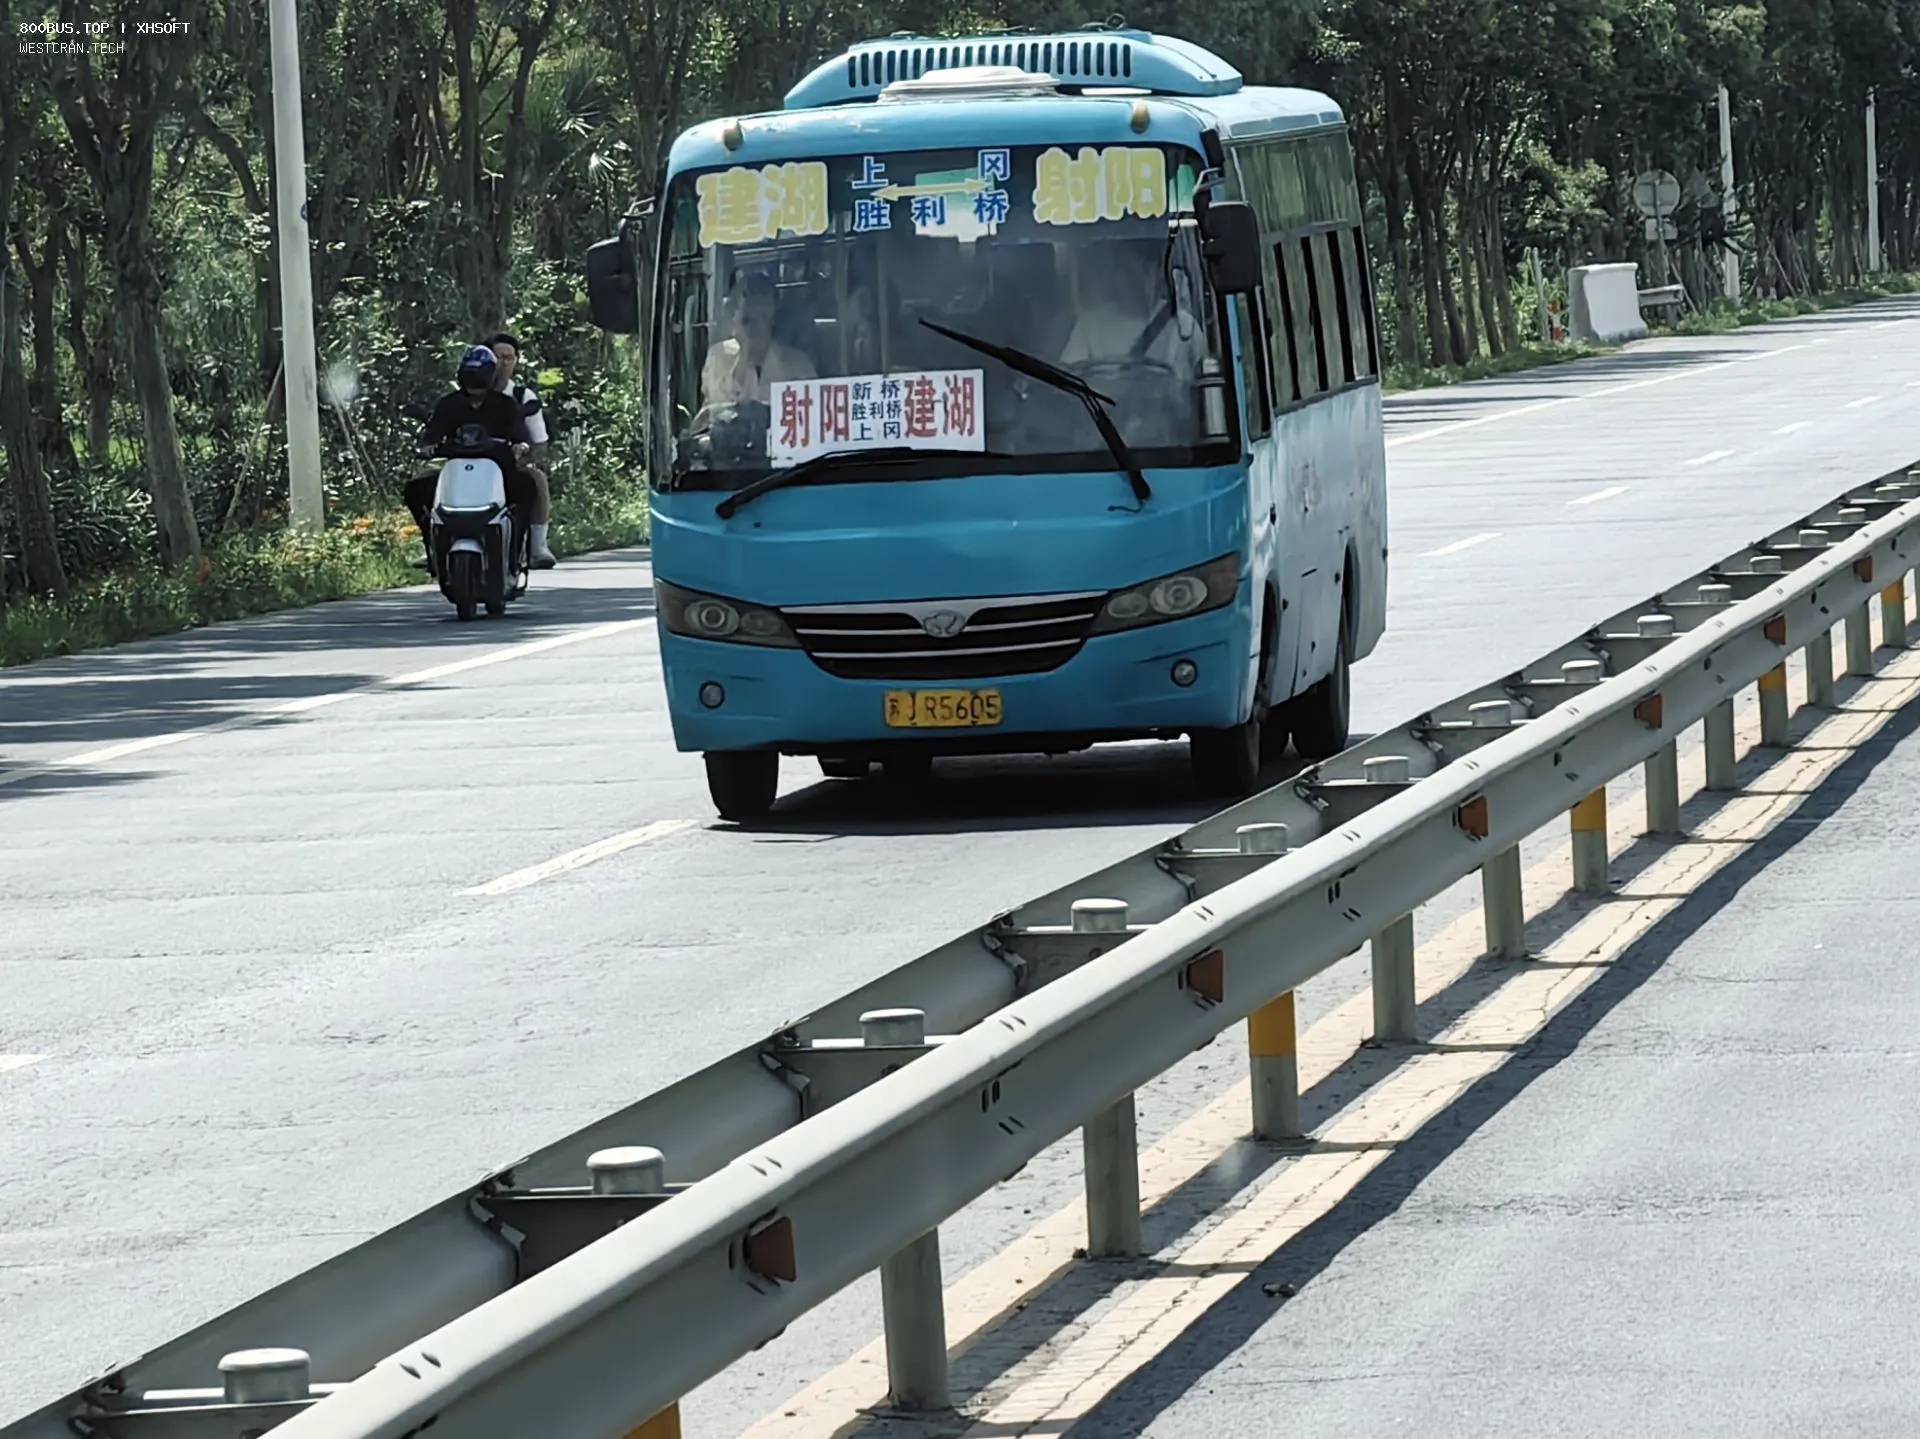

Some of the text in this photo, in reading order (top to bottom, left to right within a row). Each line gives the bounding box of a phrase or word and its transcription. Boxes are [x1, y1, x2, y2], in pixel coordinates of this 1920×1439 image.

[697, 161, 828, 248] 建湖
[853, 191, 1009, 232] 胜利桥
[1032, 146, 1167, 225] 射阳
[780, 384, 850, 449] 射阳
[851, 400, 902, 421] 胜利桥
[904, 374, 975, 438] 建湖
